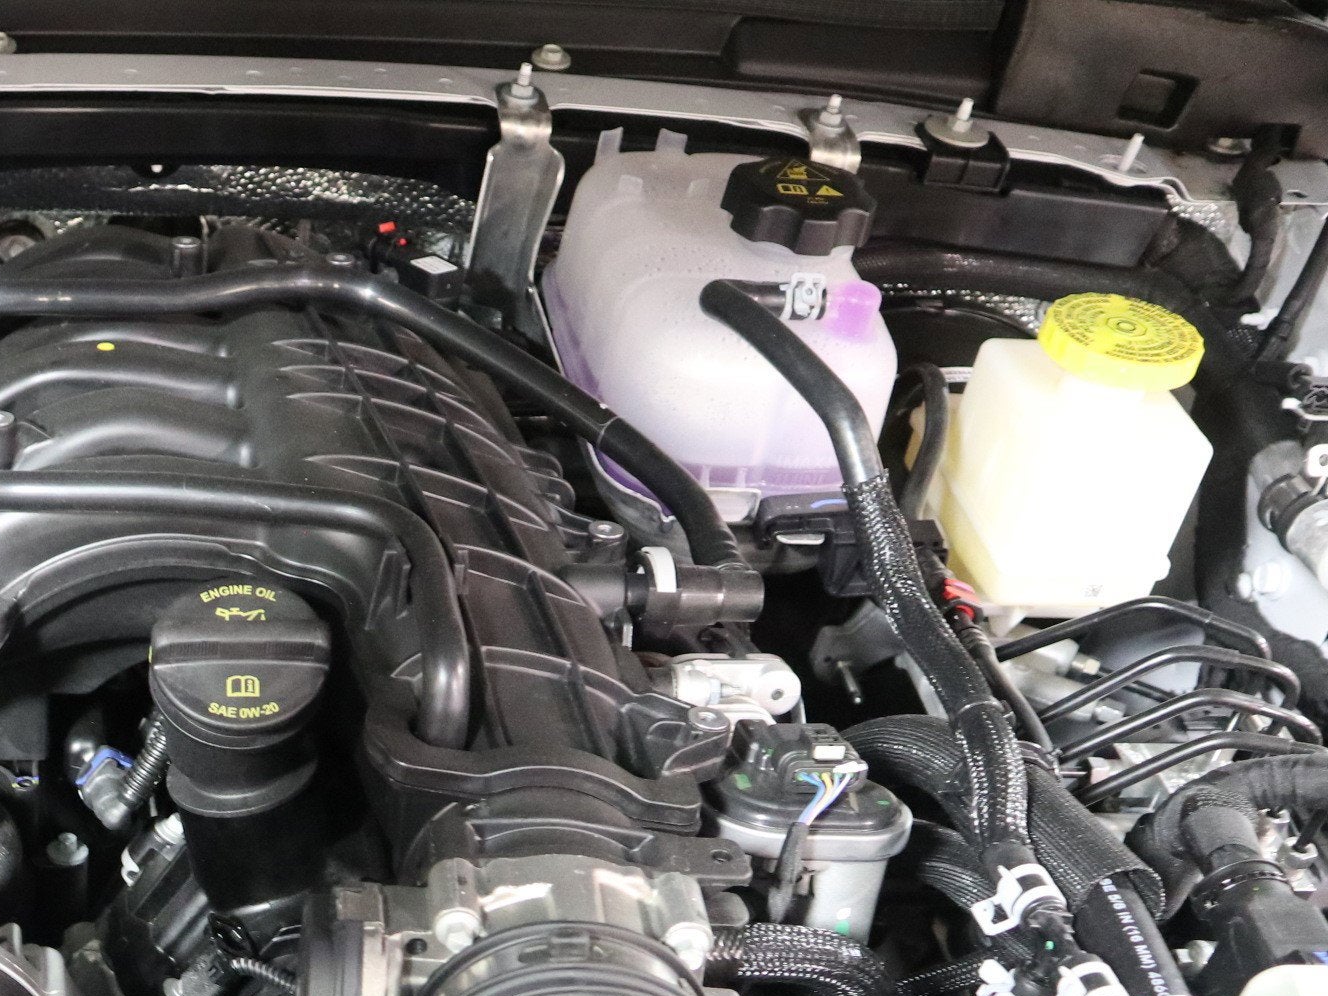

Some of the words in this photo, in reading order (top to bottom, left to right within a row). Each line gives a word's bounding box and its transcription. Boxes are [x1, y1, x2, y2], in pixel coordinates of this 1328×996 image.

[200, 585, 252, 602] ENGINE
[255, 587, 276, 601] OIL
[208, 702, 237, 718] SAE
[239, 702, 280, 718] 0W-20
[1107, 894, 1126, 910] 5/8
[1116, 911, 1135, 923] IN
[1122, 925, 1144, 942] (16
[1134, 944, 1157, 969] MM)
